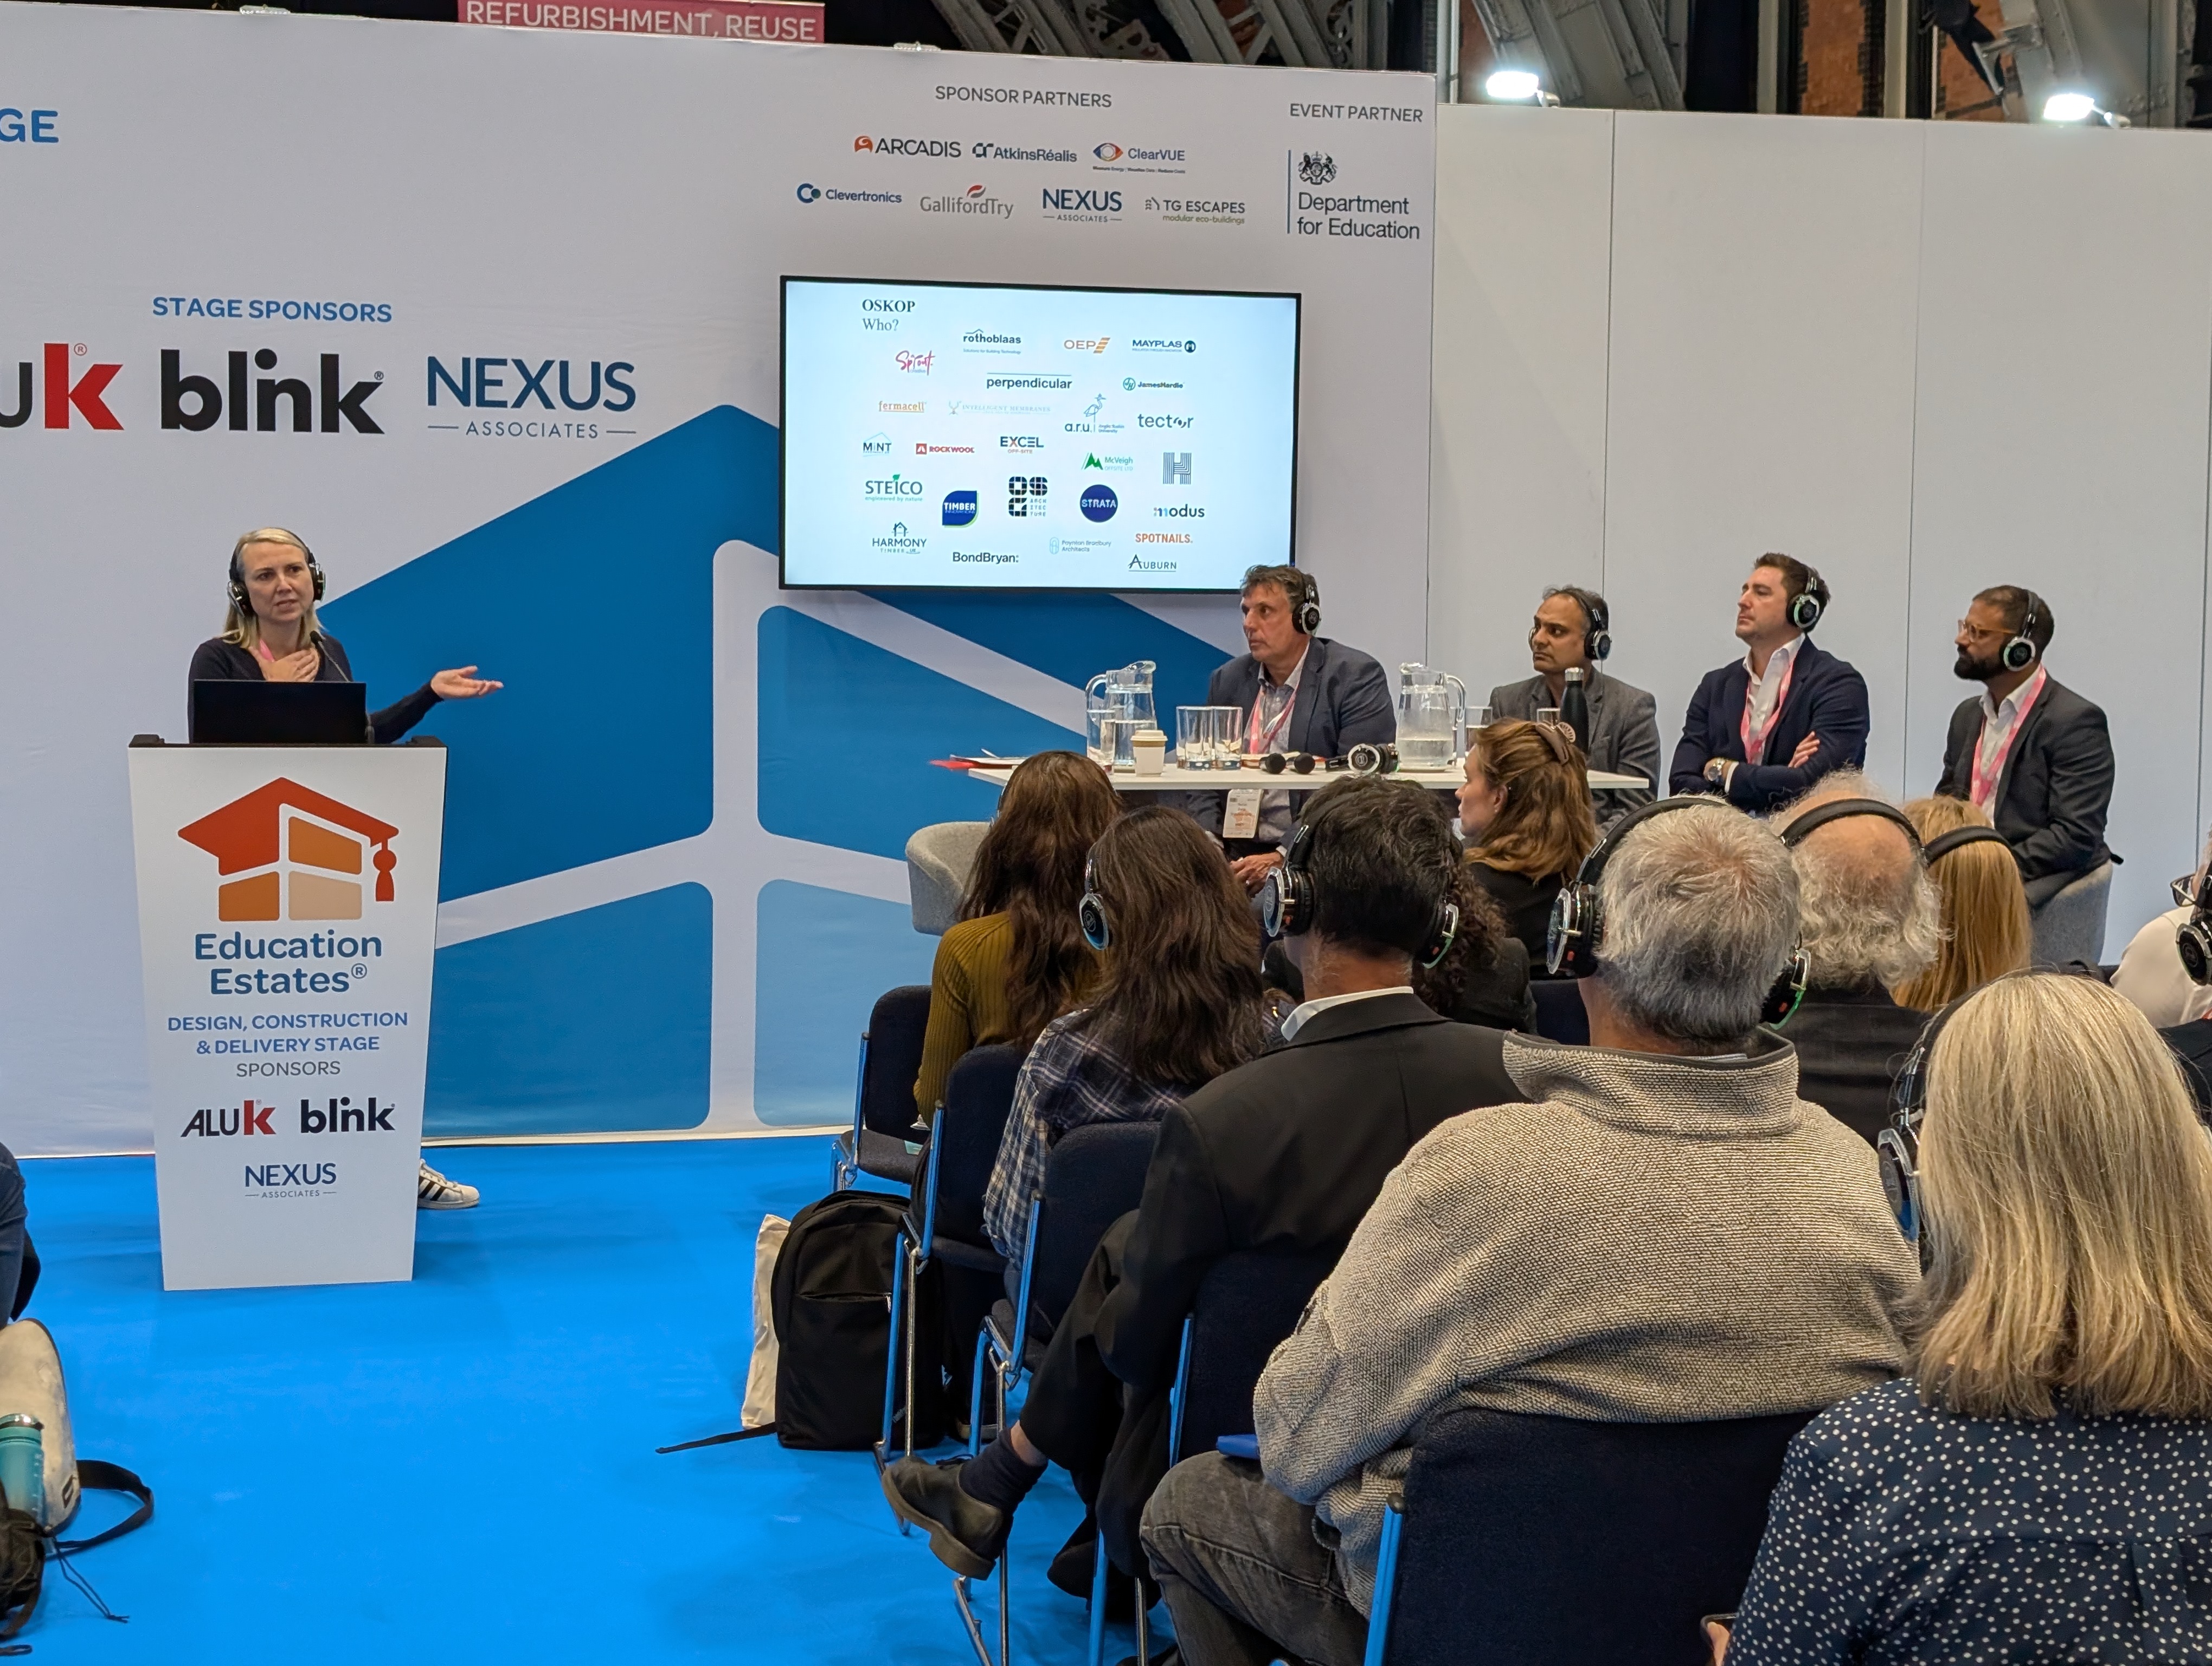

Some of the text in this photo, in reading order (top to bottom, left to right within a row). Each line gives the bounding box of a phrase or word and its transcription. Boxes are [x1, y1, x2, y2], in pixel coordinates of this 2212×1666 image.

[466, 0, 816, 41] REFURBISHMENT, REUSE
[935, 86, 1112, 108] SPONSOR PARTNERS
[1290, 104, 1423, 123] EVENT PARTNER
[0, 108, 59, 143] GE
[875, 138, 961, 157] ARCADIS
[993, 146, 1077, 162] AtkinsRéalis
[1128, 148, 1186, 162] ClearVUE
[826, 189, 902, 203] Clevertronics
[1042, 188, 1122, 212] NEXUS
[1298, 193, 1410, 214] Department
[919, 196, 1013, 219] GallifordTry
[1163, 200, 1245, 213] TG ESCAPES
[1195, 216, 1245, 225] eco-buildings
[1297, 217, 1420, 240] for Education
[152, 297, 393, 323] STAGE SPONSORS
[862, 299, 916, 312] OSKOP
[863, 318, 899, 331] Who?
[963, 334, 1021, 344] rothoblaas
[1064, 340, 1096, 350] OEP
[1133, 339, 1182, 348] MAYPLAS
[428, 356, 636, 412] NEXUS
[987, 378, 1072, 389] perpendicular
[466, 421, 599, 440] ASSOCIATES
[1000, 437, 1044, 447] EXCEL
[1105, 457, 1133, 465] McVeigh
[944, 502, 975, 510] TIMBER
[1082, 499, 1116, 508] STRATA
[872, 538, 927, 547] HARMONY
[195, 930, 382, 961] Education
[168, 1011, 409, 1033] DESIGN, CONSTRUCTION
[196, 1035, 380, 1055] & DELIVERY STAGE
[236, 1060, 341, 1078] SPONSORS
[245, 1163, 337, 1187] NEXUS
[261, 1189, 320, 1199] ASSOCIATES
